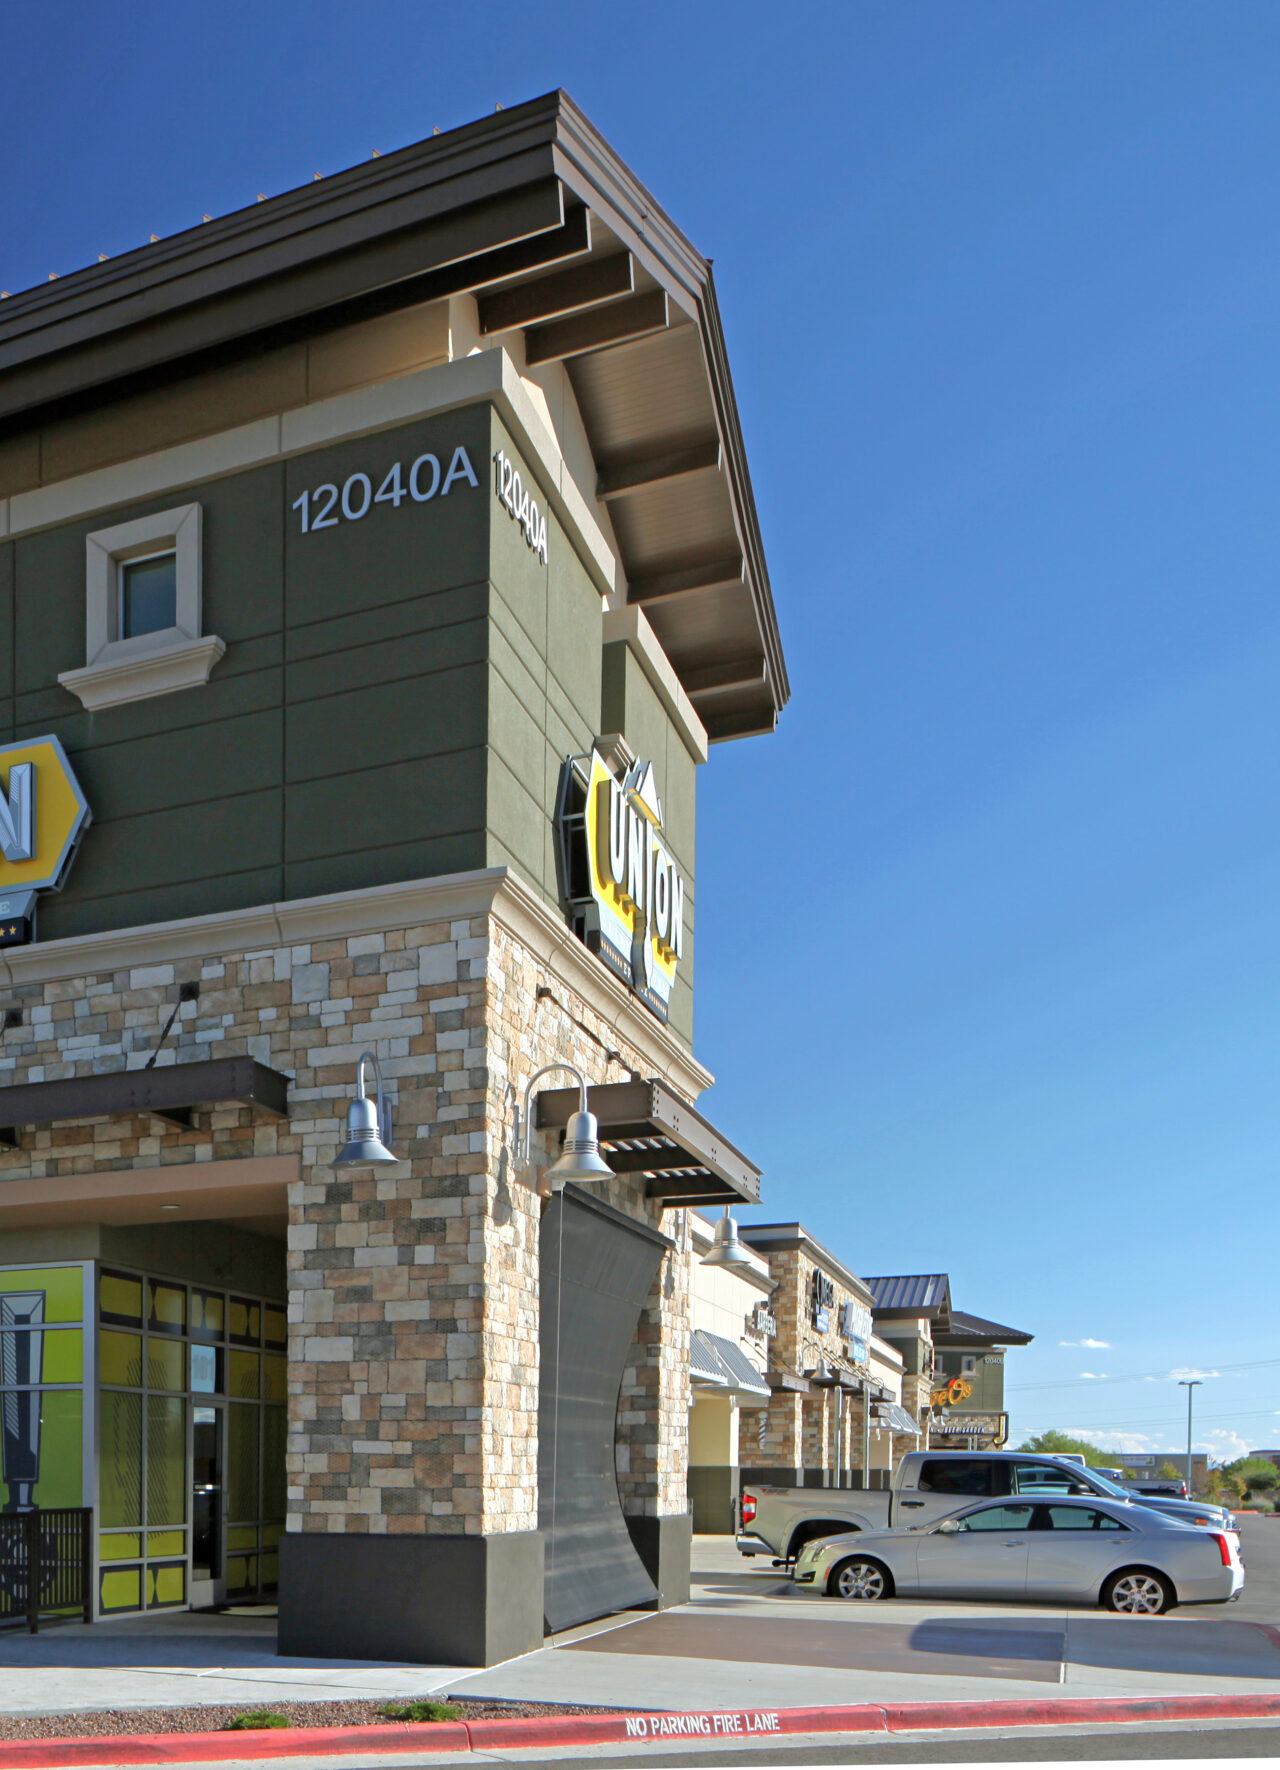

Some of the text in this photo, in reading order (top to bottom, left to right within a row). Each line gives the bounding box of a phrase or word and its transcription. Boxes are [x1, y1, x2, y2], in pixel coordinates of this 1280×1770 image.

[292, 446, 479, 533] 12040A
[494, 450, 548, 565] 12040A
[600, 779, 684, 962] UNION
[625, 1713, 781, 1736] NO PARKING FIRE LANE
